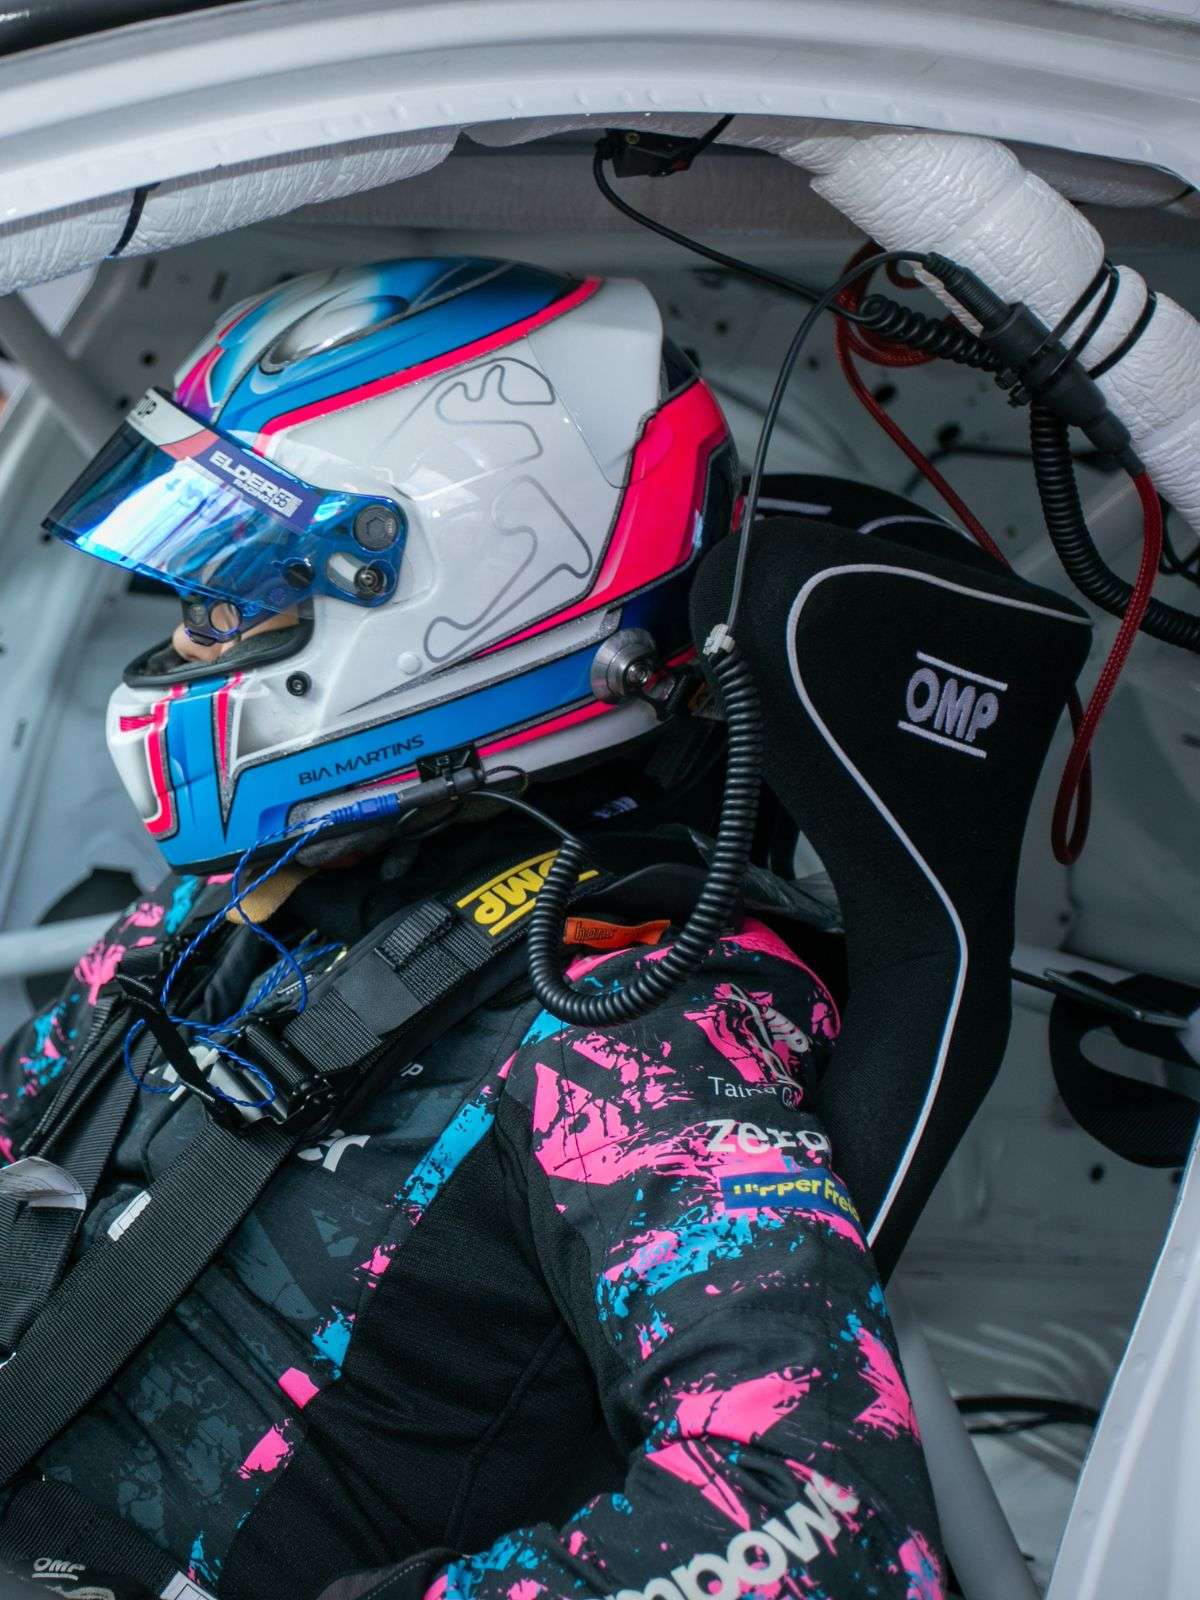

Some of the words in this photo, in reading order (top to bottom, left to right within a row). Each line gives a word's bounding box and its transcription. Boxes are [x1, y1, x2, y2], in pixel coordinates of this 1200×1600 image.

[906, 667, 999, 743] OMP
[298, 766, 332, 785] BIA
[335, 734, 425, 776] MARTINS
